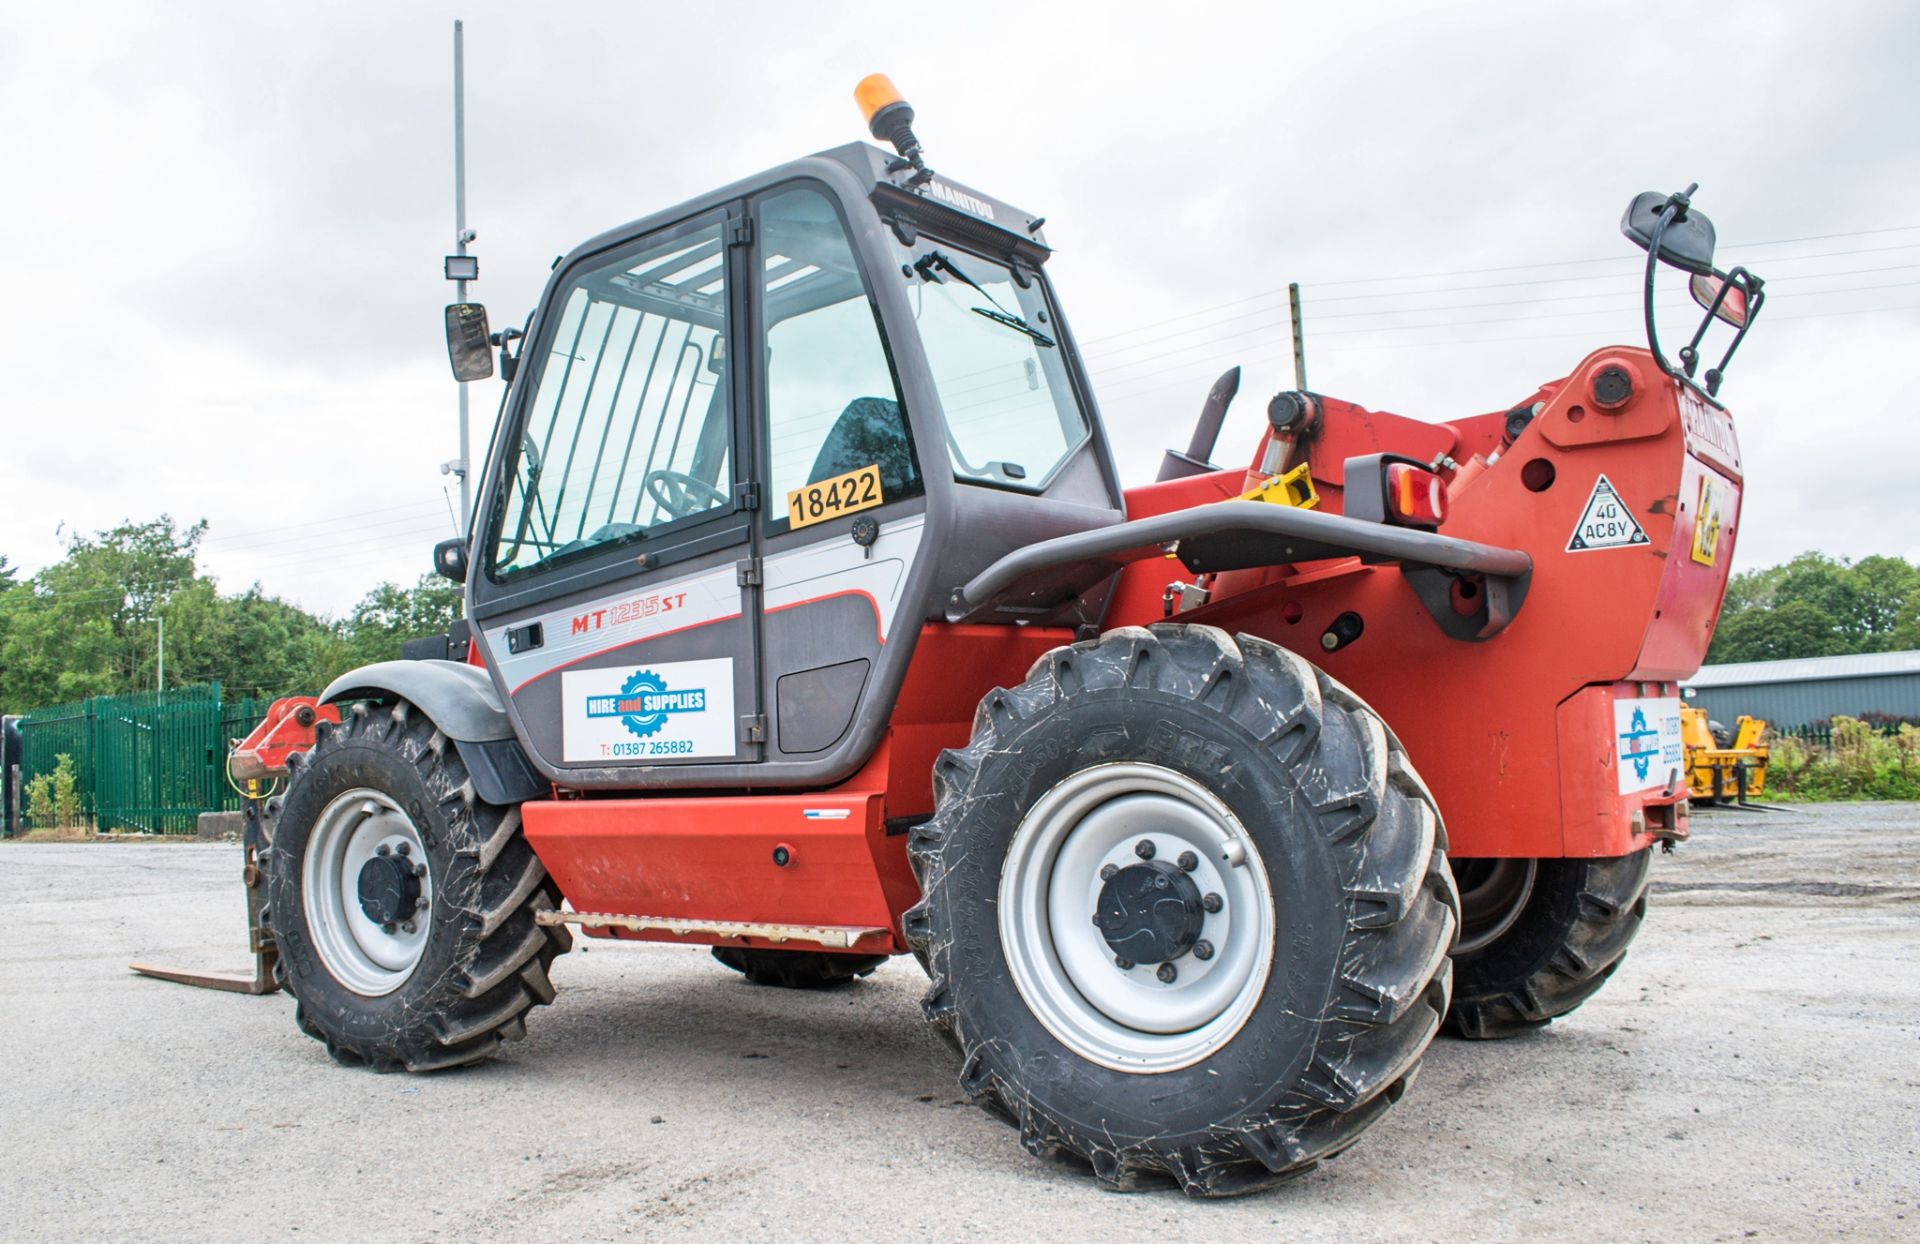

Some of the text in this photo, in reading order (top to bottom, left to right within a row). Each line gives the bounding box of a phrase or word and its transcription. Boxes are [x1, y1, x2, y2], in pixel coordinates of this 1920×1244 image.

[930, 180, 995, 221] MANITOU
[792, 472, 877, 522] 18422
[1585, 521, 1628, 539] AC8Y
[588, 692, 704, 715] HIRE and SUPPLIES
[613, 742, 646, 757] 01387
[649, 740, 694, 755] 265882
